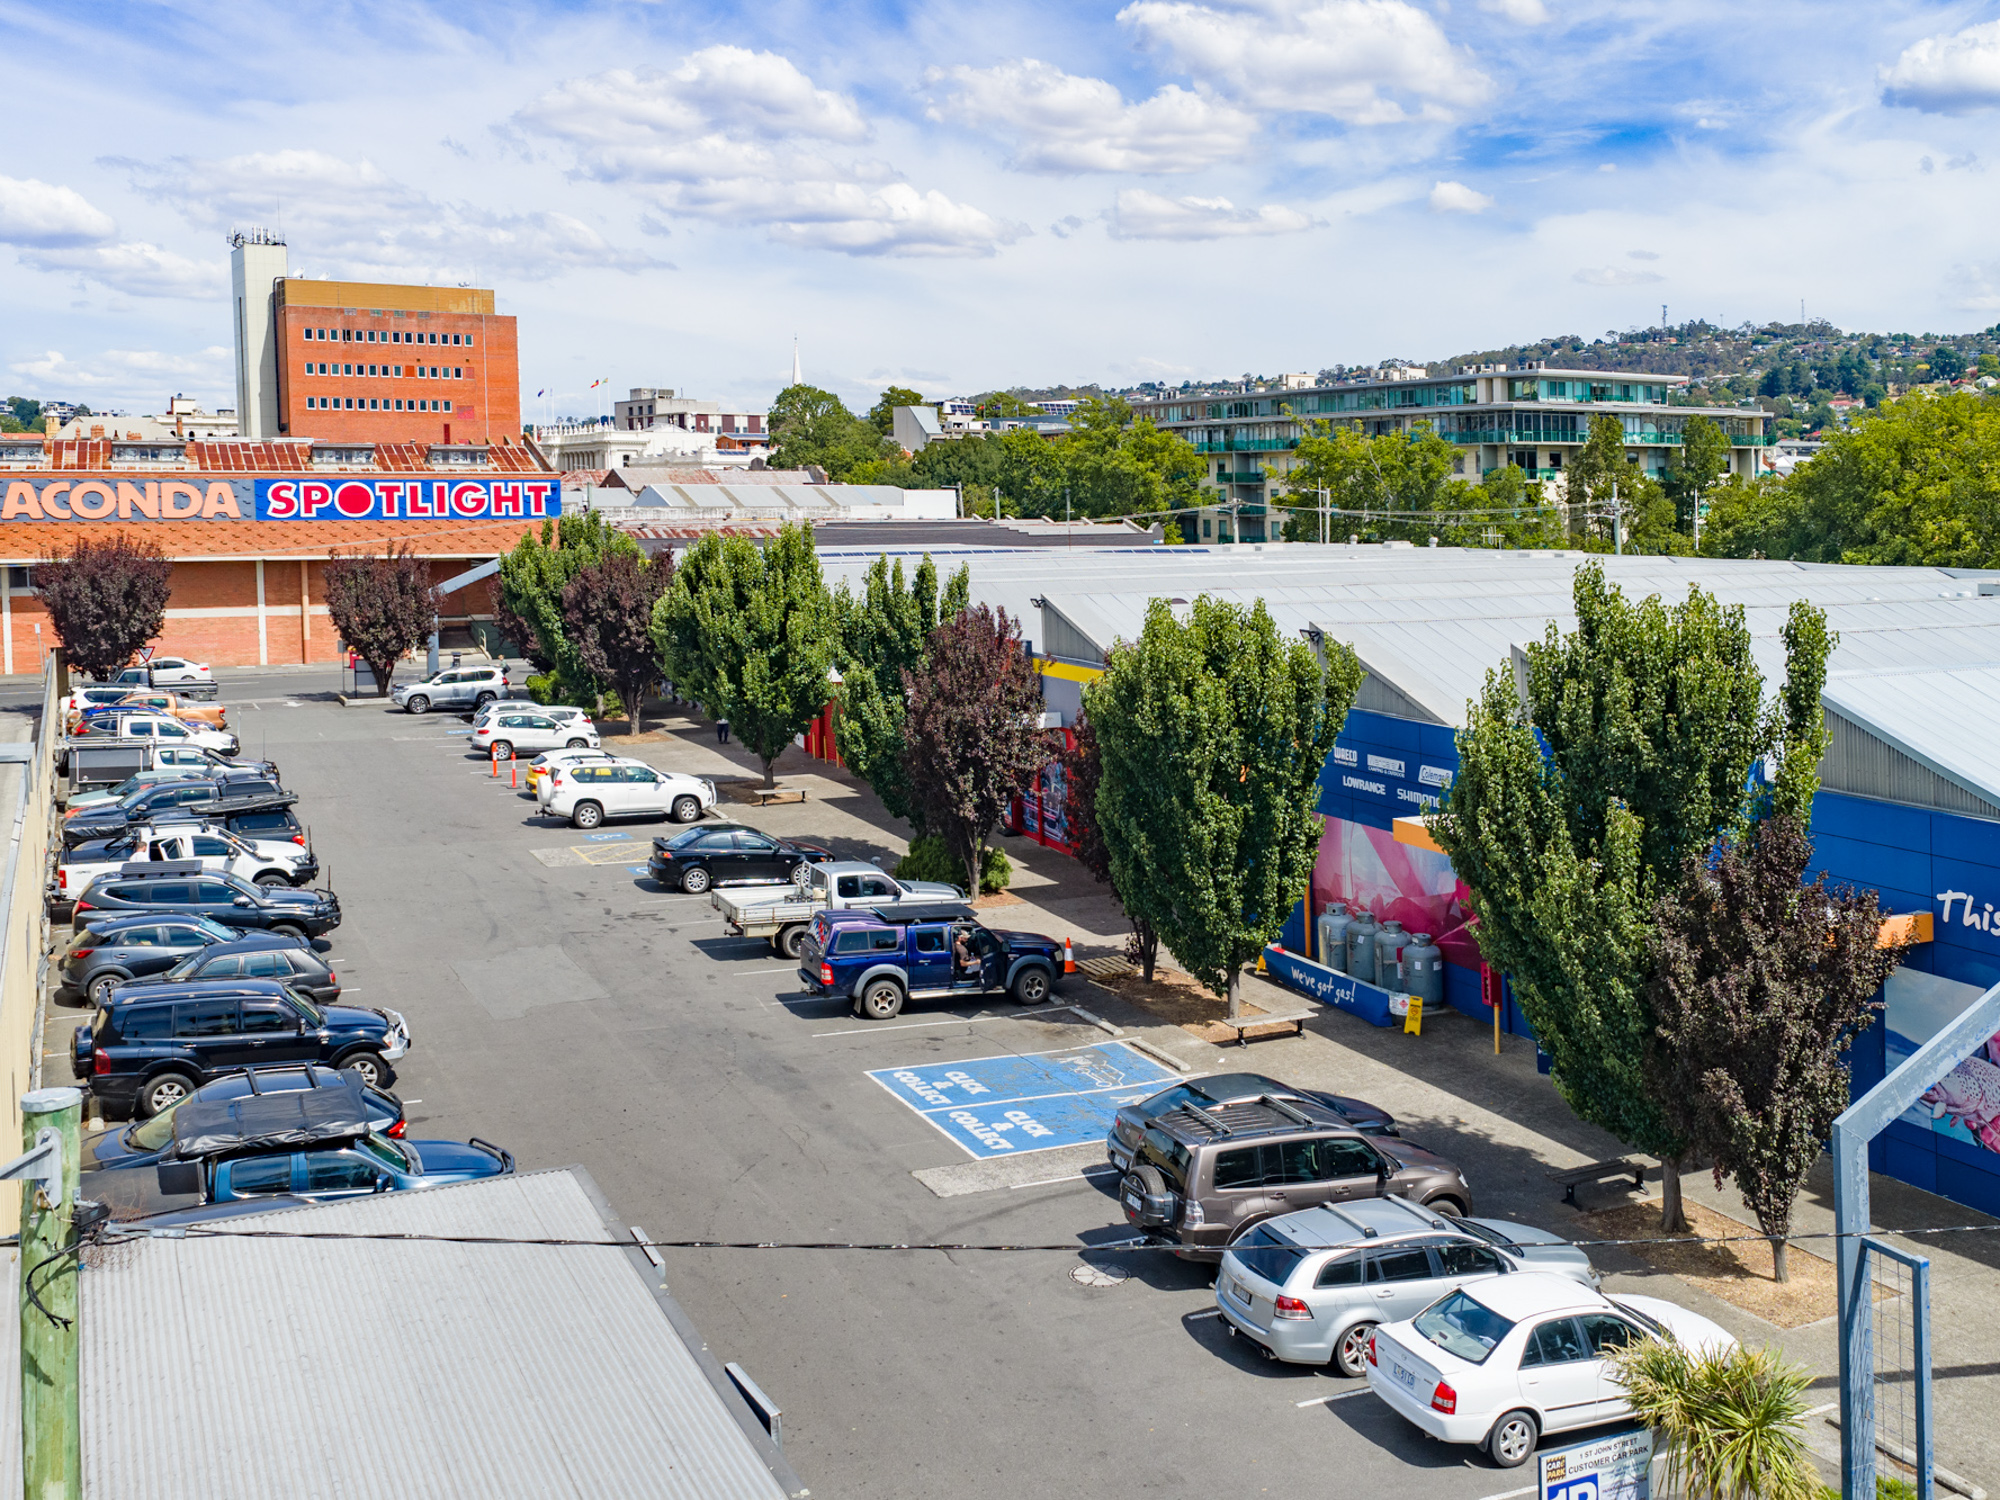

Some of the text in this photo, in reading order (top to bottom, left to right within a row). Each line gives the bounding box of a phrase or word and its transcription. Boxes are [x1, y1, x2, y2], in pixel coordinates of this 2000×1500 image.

[267, 481, 552, 518] SPOTLIGHT
[1334, 747, 1358, 762] WAECO
[1342, 775, 1386, 796] LOWRANCE
[1291, 965, 1356, 1004] We've got gas!
[893, 1071, 953, 1106] COLLECT
[933, 1081, 954, 1090] &
[944, 1070, 991, 1095] CLICK
[949, 1110, 1015, 1151] COLLECT
[991, 1122, 1014, 1132] &
[1003, 1110, 1055, 1138] CLICK
[1568, 1444, 1649, 1474] CUSTOMER CAR PARK
[1585, 1449, 1593, 1458] ST
[1594, 1445, 1612, 1455] JOHN
[1613, 1438, 1637, 1450] STREET
[1547, 1467, 1566, 1479] PARK
